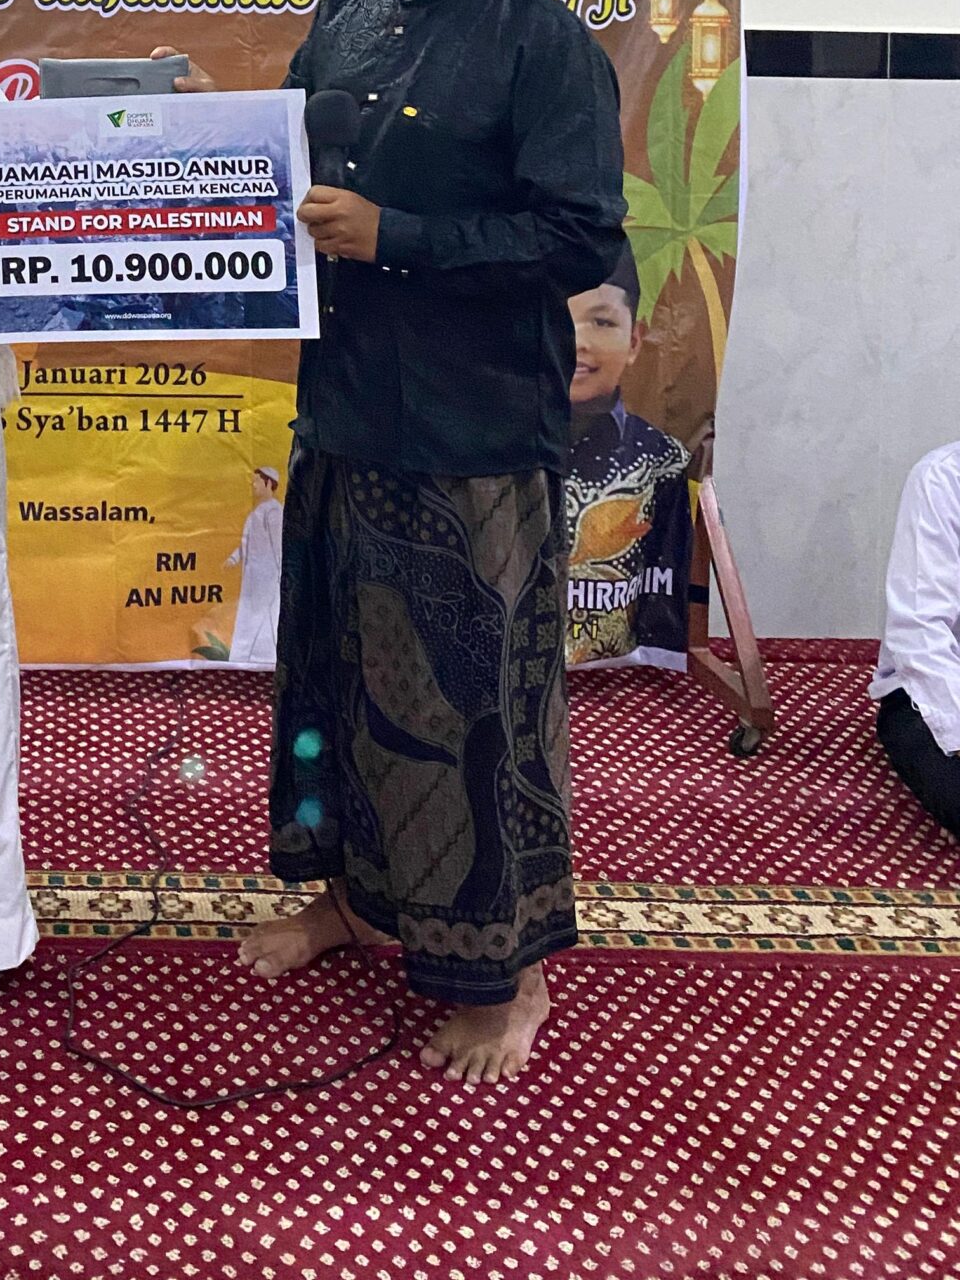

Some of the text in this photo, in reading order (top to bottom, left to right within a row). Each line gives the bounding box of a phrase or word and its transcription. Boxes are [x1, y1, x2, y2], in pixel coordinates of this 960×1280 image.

[97, 162, 180, 179] MASJID
[187, 159, 270, 177] ANNUR
[96, 185, 139, 198] VILLA
[144, 183, 195, 196] PALEM
[199, 181, 275, 195] KENCANA
[7, 211, 263, 233] STAND FOR PALESTINIAN
[1, 251, 274, 285] RP. 10.900.000
[20, 360, 207, 391] Januari 2026
[139, 409, 208, 433] 1447
[217, 409, 242, 433] H
[19, 501, 156, 524] Wassalam,
[156, 552, 197, 572] RM
[125, 584, 223, 608] AN NUR
